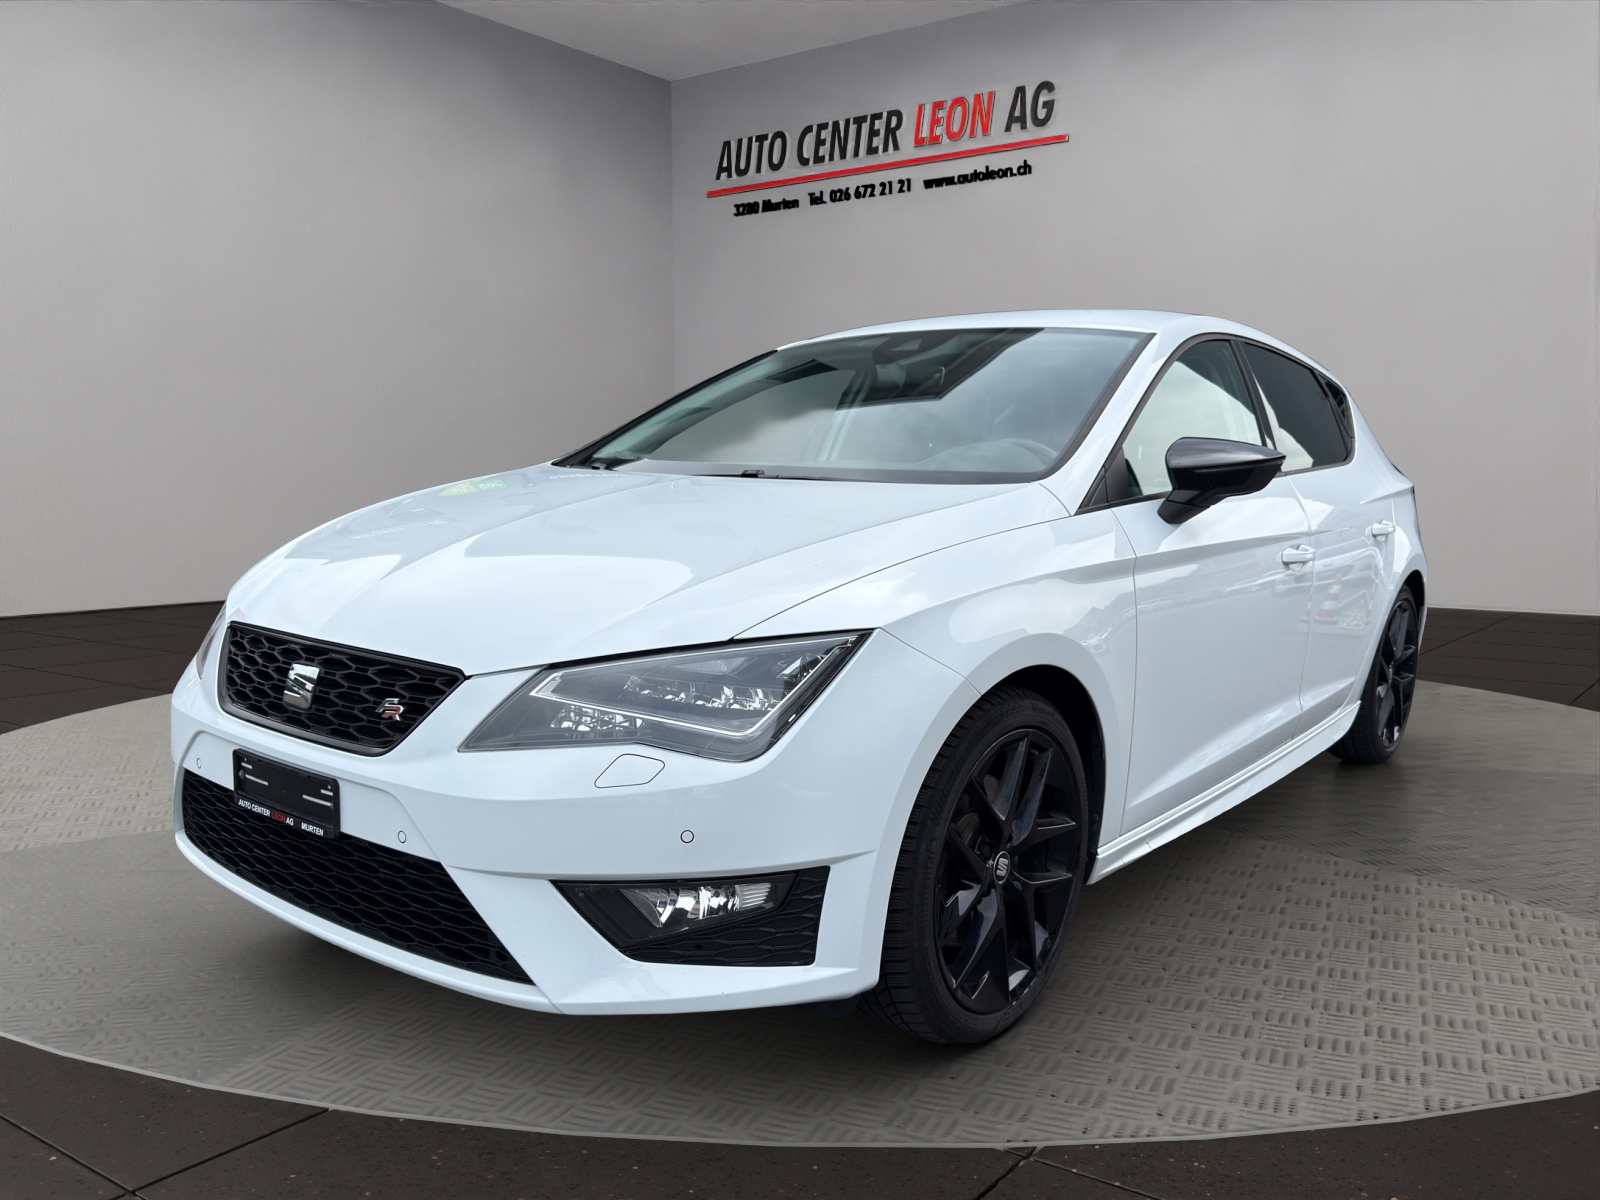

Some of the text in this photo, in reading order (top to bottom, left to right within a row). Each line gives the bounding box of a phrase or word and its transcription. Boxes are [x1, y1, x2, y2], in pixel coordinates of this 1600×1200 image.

[715, 81, 1056, 181] AUTO CENTER LEON AG
[807, 190, 828, 206] Tel.
[829, 187, 851, 203] 026
[854, 183, 876, 199] 672
[879, 181, 893, 196] 21
[897, 178, 912, 193] 21
[922, 159, 1032, 189] www.autoleon.ch
[376, 698, 404, 721] FR
[238, 799, 324, 836] AUTO CENTER LEON AG MURTEN
